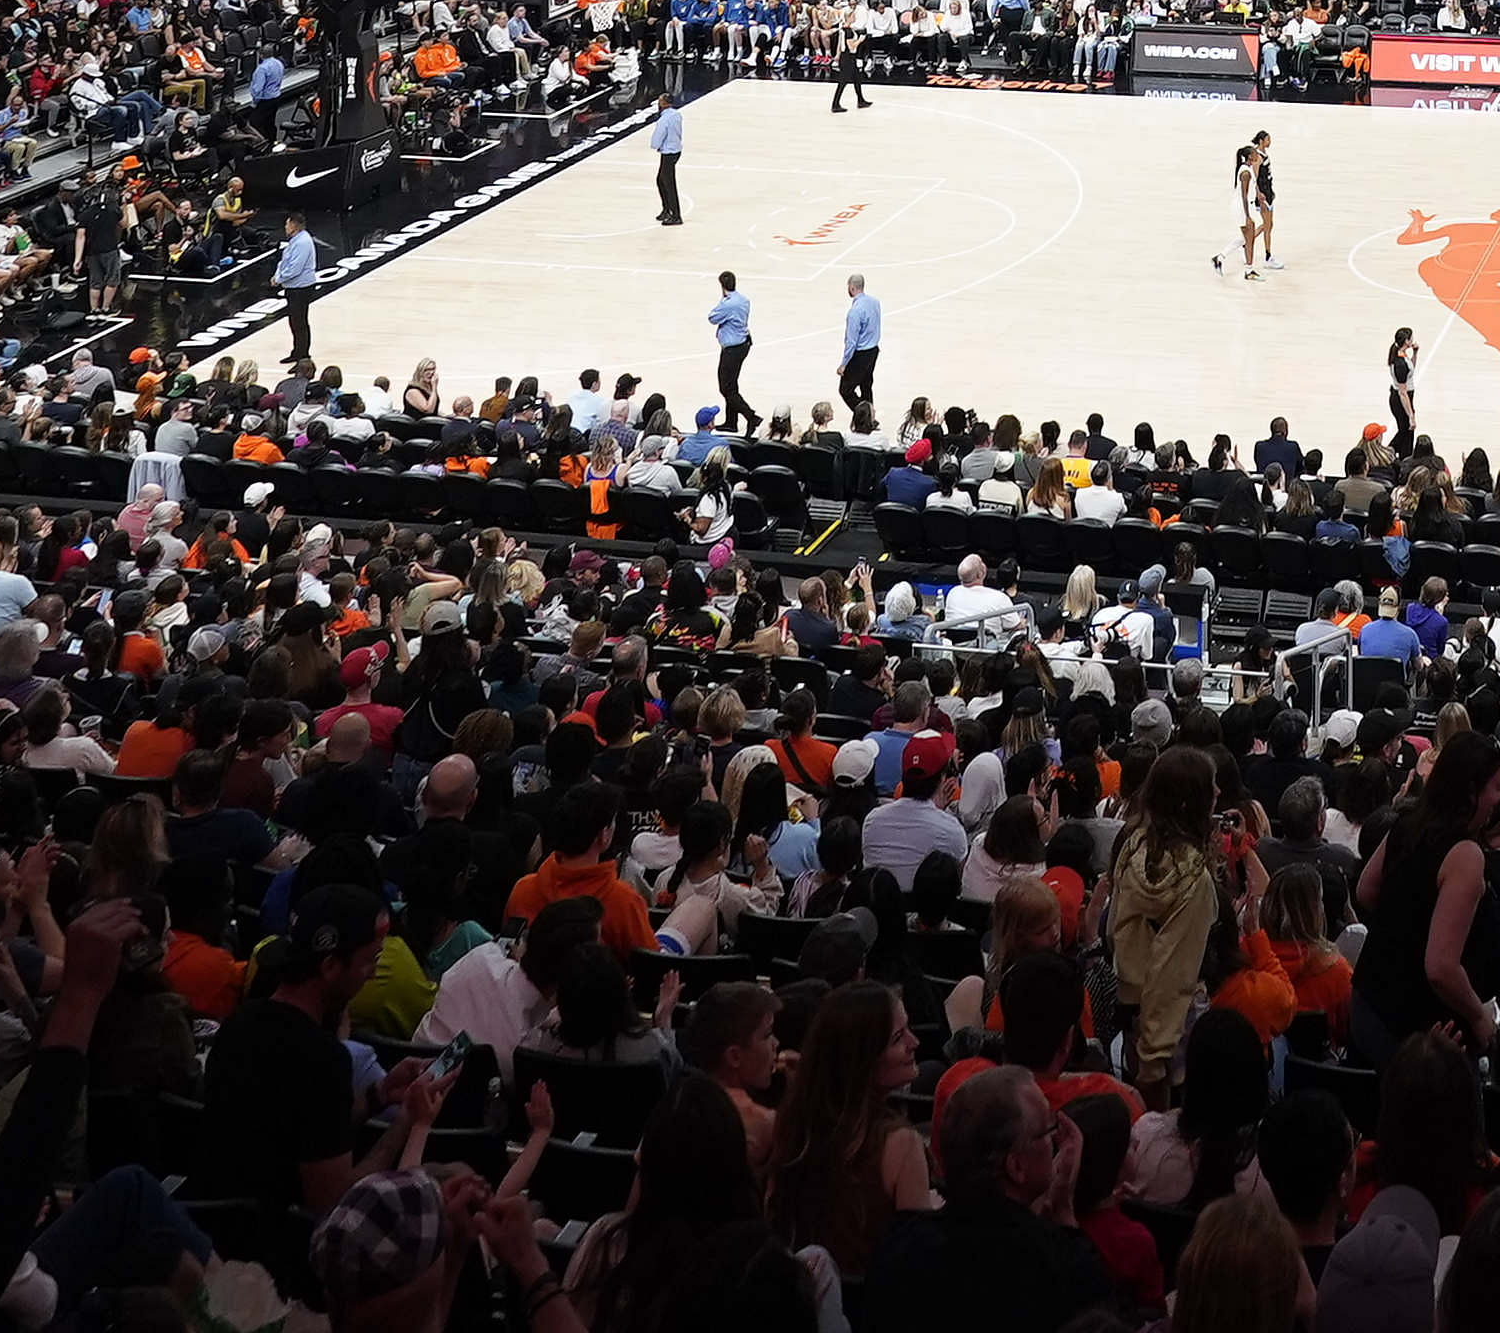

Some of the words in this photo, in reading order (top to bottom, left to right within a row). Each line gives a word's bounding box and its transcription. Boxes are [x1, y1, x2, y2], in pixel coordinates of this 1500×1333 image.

[1142, 44, 1238, 61] WNBA.COM
[1410, 53, 1477, 74] VISIT
[317, 206, 468, 290] CANADA
[455, 161, 557, 209] GAME
[803, 202, 873, 239] WNBA
